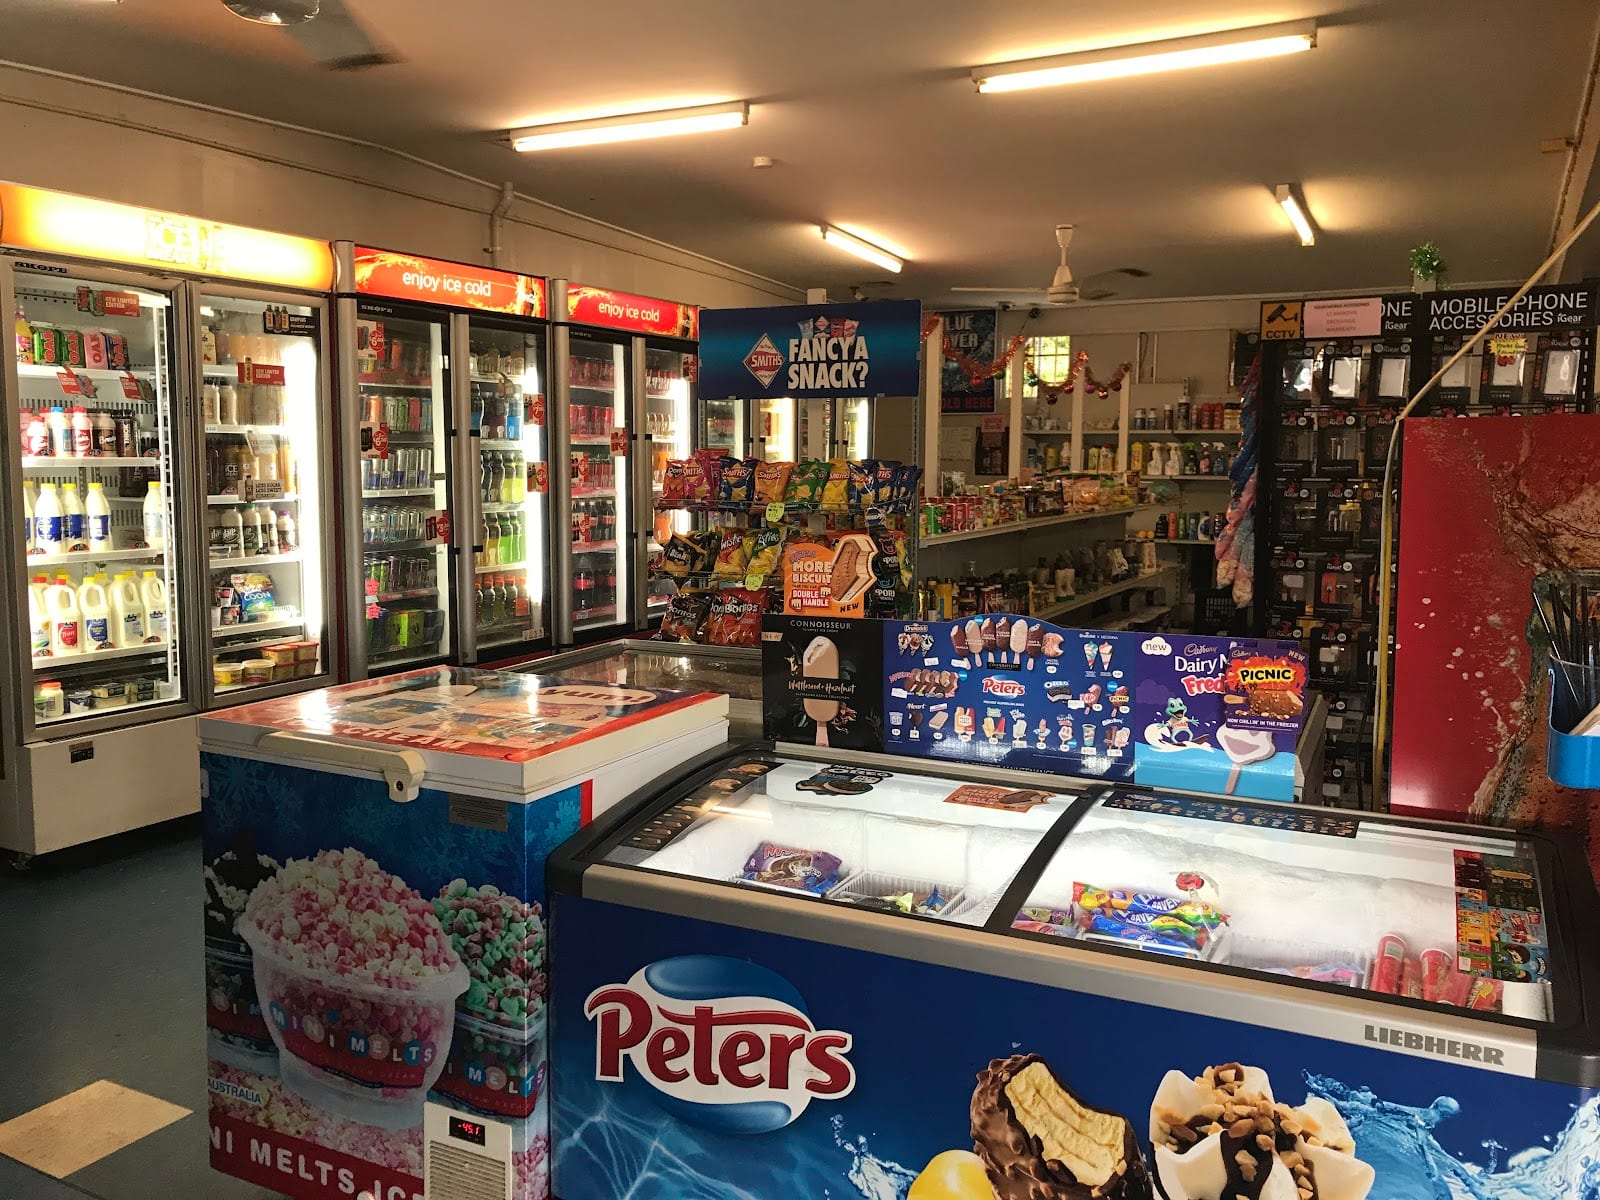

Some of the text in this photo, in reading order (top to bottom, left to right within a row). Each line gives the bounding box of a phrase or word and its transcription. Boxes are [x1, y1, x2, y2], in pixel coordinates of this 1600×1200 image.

[14, 261, 68, 274] SKOPE
[402, 270, 492, 297] enjoy ice cold
[1430, 292, 1588, 316] MOBILE PHONE
[598, 301, 660, 323] enjoy ice cold
[944, 313, 974, 331] LUE
[1384, 320, 1408, 330] iGear
[1428, 311, 1583, 331] ACCESSORIES iGear
[1265, 329, 1296, 339] CCTV
[788, 335, 869, 363] FANCY A
[787, 361, 869, 390] SNACK?
[792, 561, 833, 573] MORE
[792, 573, 833, 584] BISCUIT
[243, 591, 271, 601] COON
[792, 589, 819, 599] DOUBLE
[725, 603, 759, 614] Doritos
[802, 599, 829, 607] HANDLE
[840, 602, 860, 613] NEW
[790, 619, 852, 630] CONNOISSEUR
[1145, 643, 1168, 651] new
[1183, 643, 1219, 657] Cadbury
[1288, 650, 1305, 662] NEW
[1174, 655, 1218, 675] Dairy
[1240, 669, 1292, 682] PICNIC
[788, 680, 821, 691] Wattleseed
[825, 682, 857, 695] Hazelnut
[982, 676, 1026, 696] Peters
[536, 689, 652, 703] yum!
[342, 726, 470, 750] CREAM
[271, 1005, 434, 1063] MINI MELTS
[586, 986, 852, 1096] Peters
[1364, 1024, 1505, 1066] LIEBHERR
[468, 1066, 544, 1094] MELTS
[206, 1077, 262, 1104] AUSTRALIA
[249, 1138, 356, 1194] MELTS
